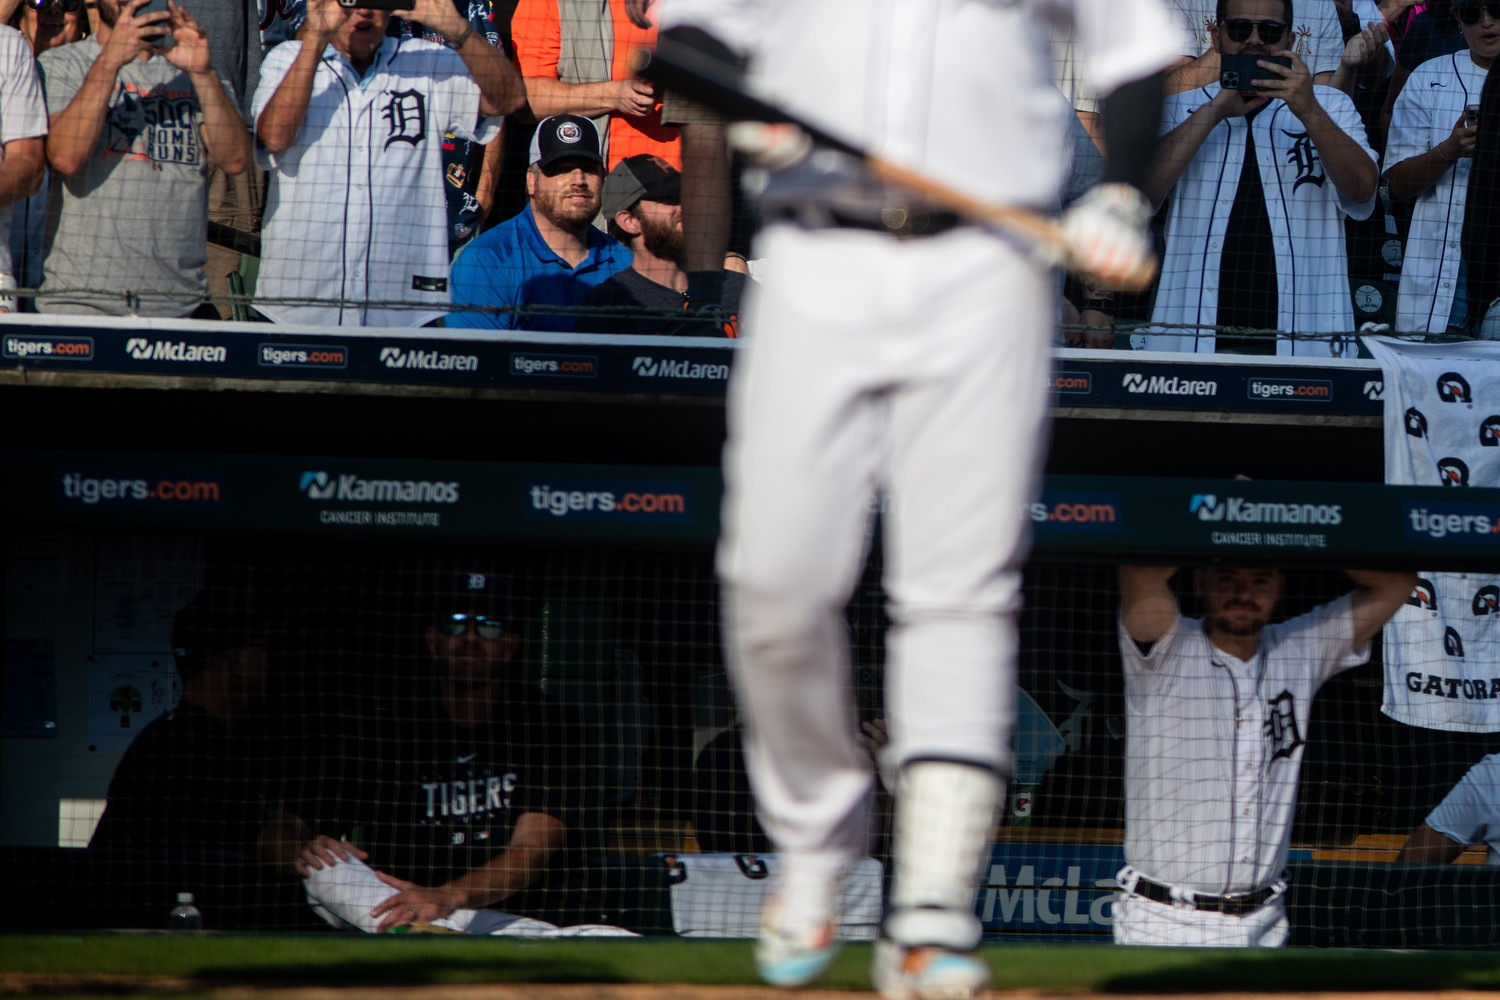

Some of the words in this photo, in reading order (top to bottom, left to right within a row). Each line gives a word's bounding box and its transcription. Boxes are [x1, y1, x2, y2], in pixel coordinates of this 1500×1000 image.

[141, 99, 193, 128] 500
[384, 90, 426, 148] D
[148, 127, 196, 145] HOME
[148, 145, 196, 162] RUNS
[7, 338, 90, 356] tigers.com
[152, 340, 226, 362] McLaren
[262, 346, 345, 365] tigers.com
[404, 349, 478, 371] McLaren
[513, 355, 594, 375] tigers.com
[658, 359, 729, 381] McLaren
[1148, 376, 1217, 396] McLaren
[1251, 381, 1329, 398] tigers.com
[63, 473, 219, 504] tigers.com
[337, 475, 459, 503] Karmanos
[531, 486, 685, 516] tigers.com
[1226, 498, 1341, 526] Karmanos
[320, 510, 371, 525] CANCER
[374, 510, 440, 526] INSTITUTE
[1211, 531, 1261, 545] CANCER
[1264, 532, 1326, 546] INSTITUTE
[1265, 690, 1303, 762] D
